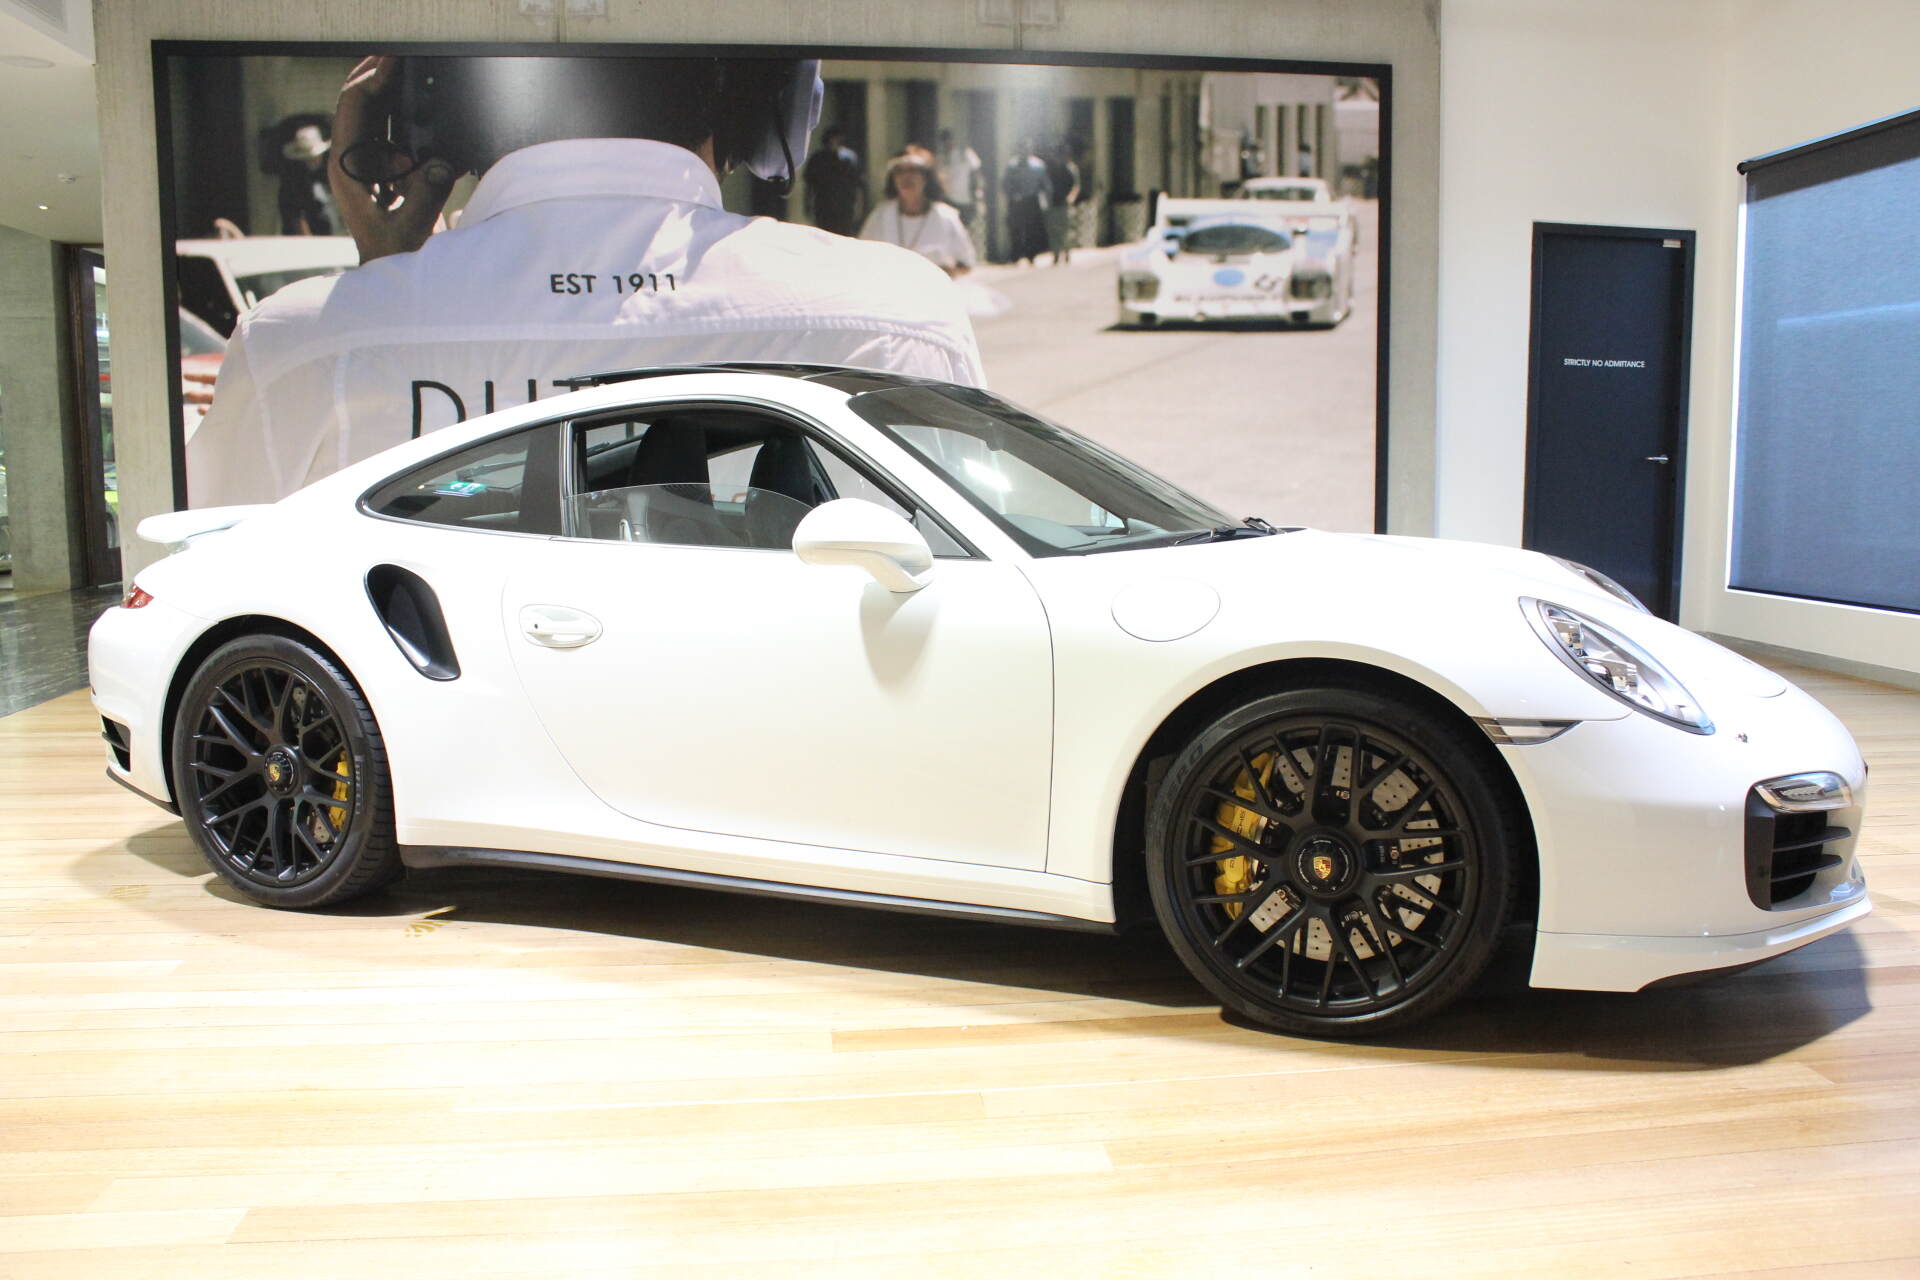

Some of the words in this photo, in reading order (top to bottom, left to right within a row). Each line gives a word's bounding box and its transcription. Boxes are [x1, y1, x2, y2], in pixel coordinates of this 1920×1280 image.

[550, 273, 597, 295] EST
[612, 273, 675, 294] 1911
[1563, 358, 1591, 367] STRICTLY
[1592, 359, 1603, 367] NO
[1604, 360, 1646, 369] ADMITTANCE
